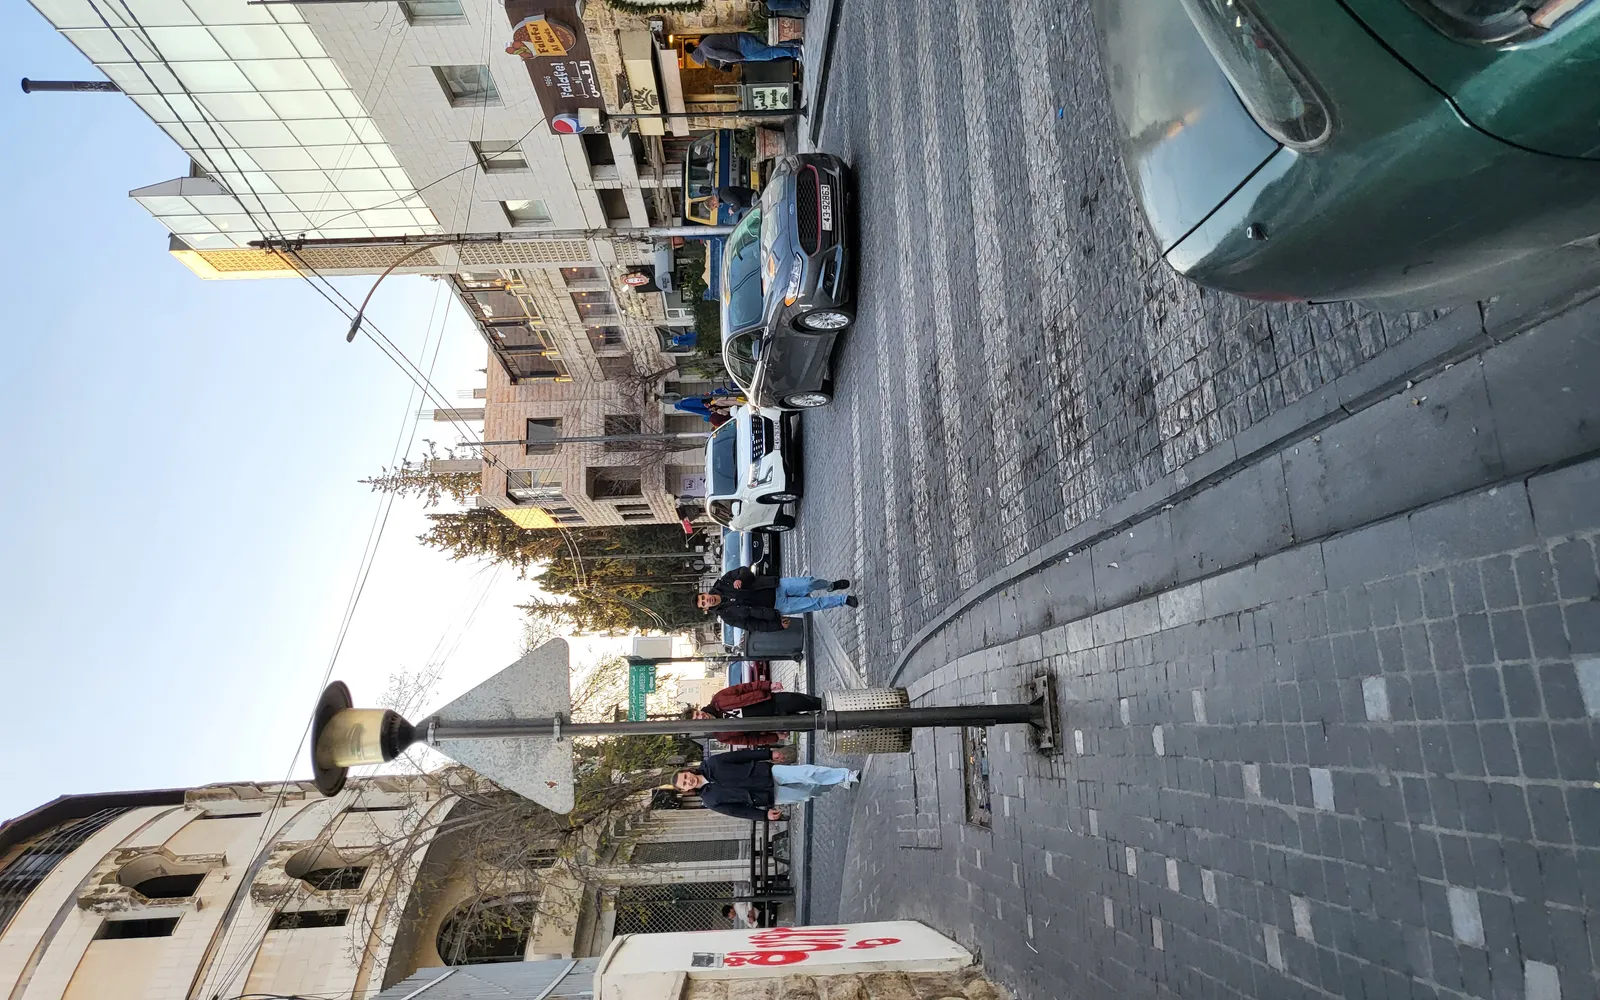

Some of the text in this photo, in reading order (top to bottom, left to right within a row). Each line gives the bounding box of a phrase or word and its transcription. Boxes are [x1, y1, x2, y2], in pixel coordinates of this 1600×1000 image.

[530, 24, 549, 54] Falafel
[550, 62, 575, 98] Falafel
[566, 60, 590, 98] فلافل
[579, 60, 600, 98] القدس
[821, 186, 830, 222] 43-92863
[648, 666, 655, 675] 10
